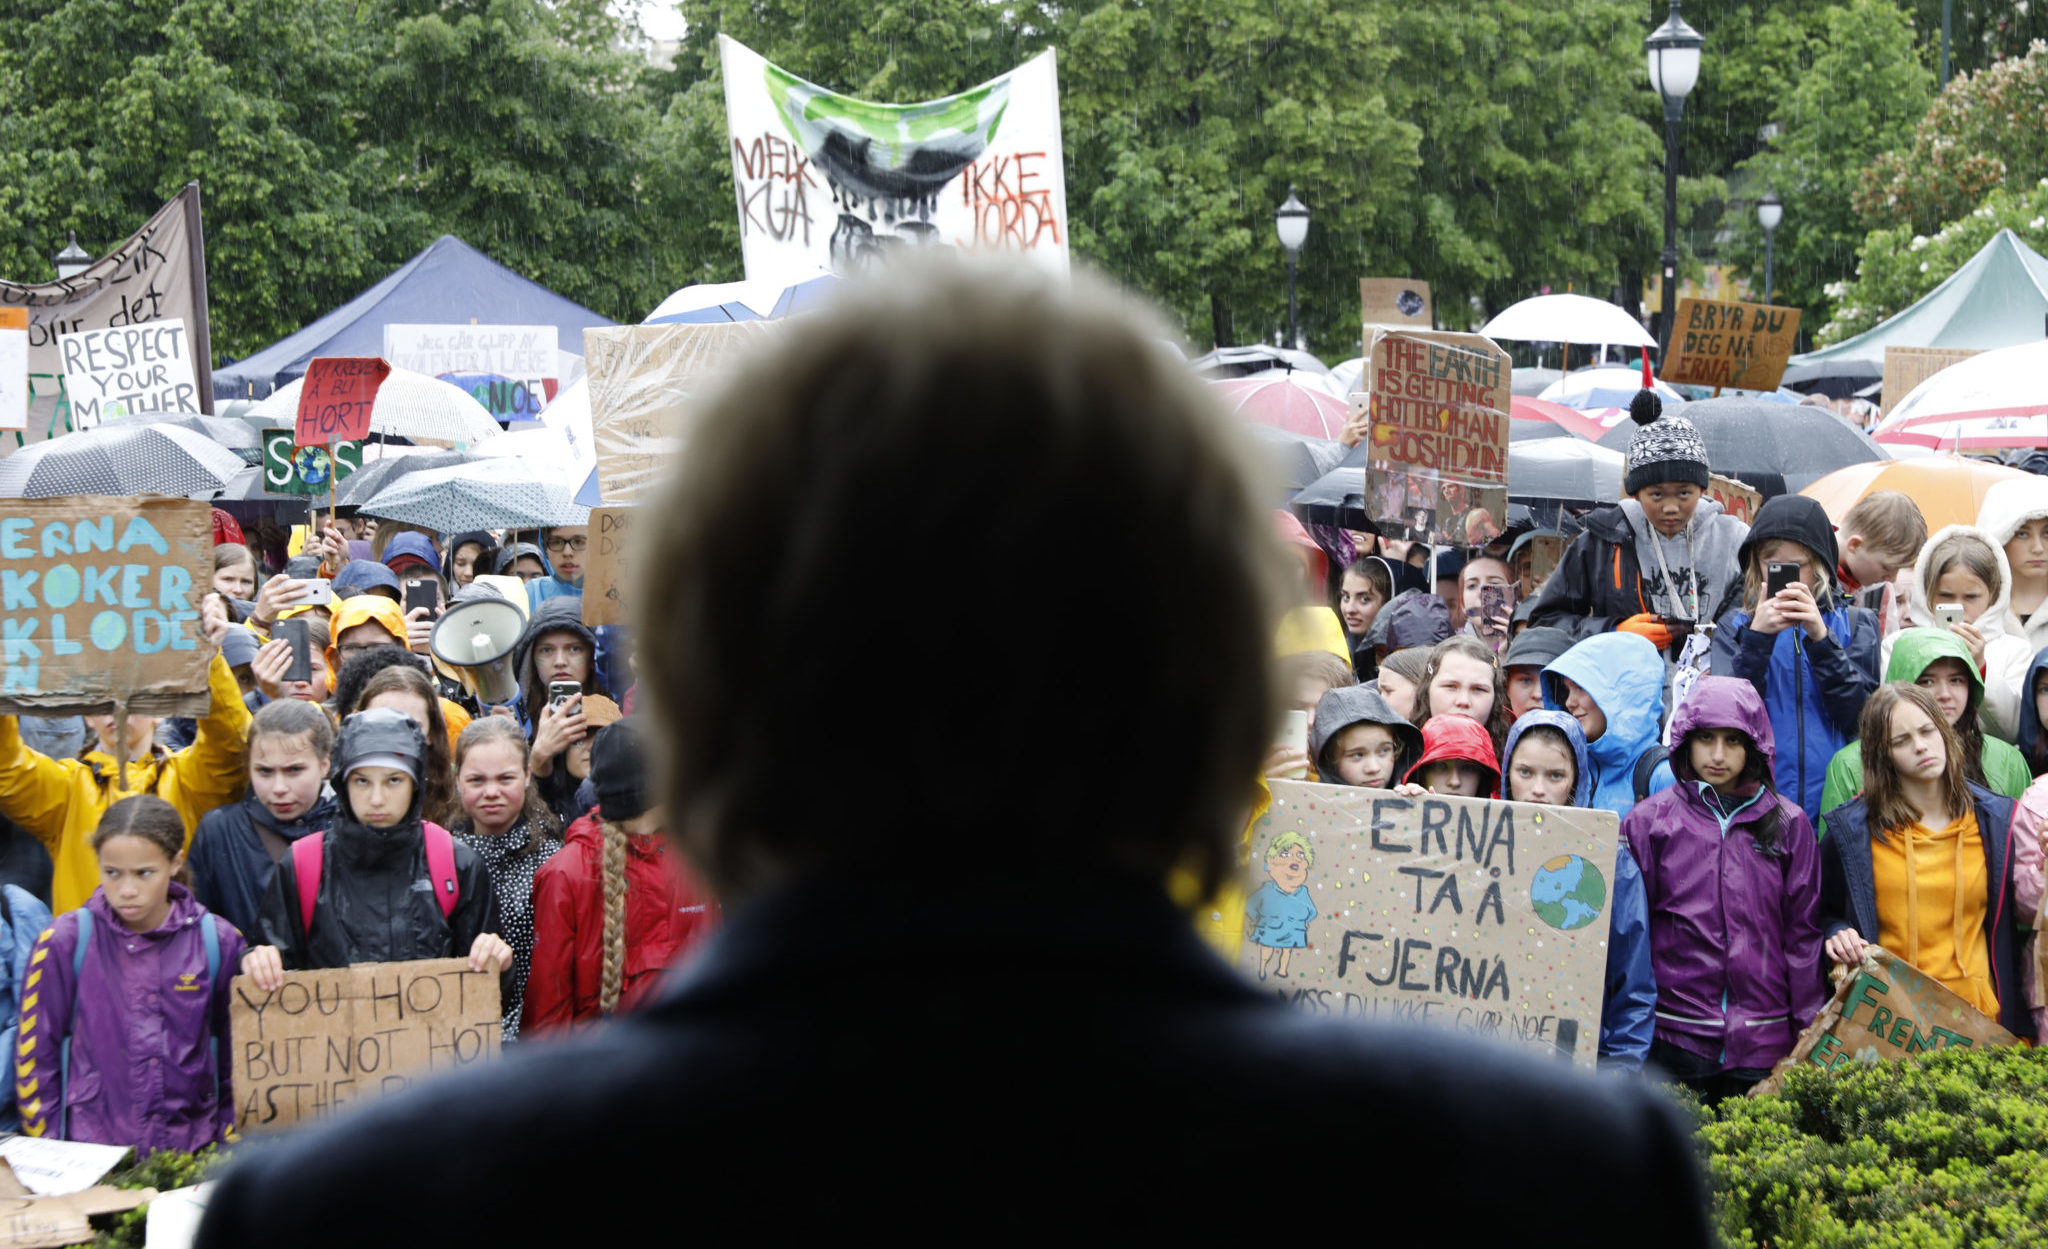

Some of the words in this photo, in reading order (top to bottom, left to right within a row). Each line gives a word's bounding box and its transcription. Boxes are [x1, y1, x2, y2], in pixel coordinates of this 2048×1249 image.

[735, 132, 817, 187] MELK
[962, 151, 1050, 208] IKKE
[740, 180, 814, 248] KUA
[110, 283, 163, 328] det
[1689, 303, 1744, 331] BRYR
[1752, 308, 1787, 334] DU
[63, 327, 184, 375] RESPECT
[417, 333, 444, 350] JEG
[478, 333, 516, 351] GLIPP
[519, 331, 538, 350] AV
[1382, 338, 1427, 375] THE
[1430, 344, 1501, 388] EARTH
[1684, 332, 1722, 355] DEG
[91, 364, 169, 397] YOUR
[308, 378, 322, 399] Å
[330, 379, 356, 397] BLI
[1377, 368, 1402, 396] IS
[1404, 373, 1496, 410] GETTING
[301, 401, 372, 438] HØRT
[1445, 405, 1499, 446] THAN
[0, 515, 171, 560] ERNA
[0, 563, 193, 612] KOKER
[3, 608, 200, 664] KLODE
[1370, 798, 1516, 876] ERNA
[1398, 866, 1463, 915] TA
[1475, 866, 1506, 926] Å
[1337, 930, 1511, 1002] FJERNA
[236, 981, 340, 1041] YOU
[371, 969, 489, 1023] HOT
[246, 1035, 317, 1082] BUT
[326, 1027, 409, 1074] NOT
[428, 1021, 500, 1072] HOT
